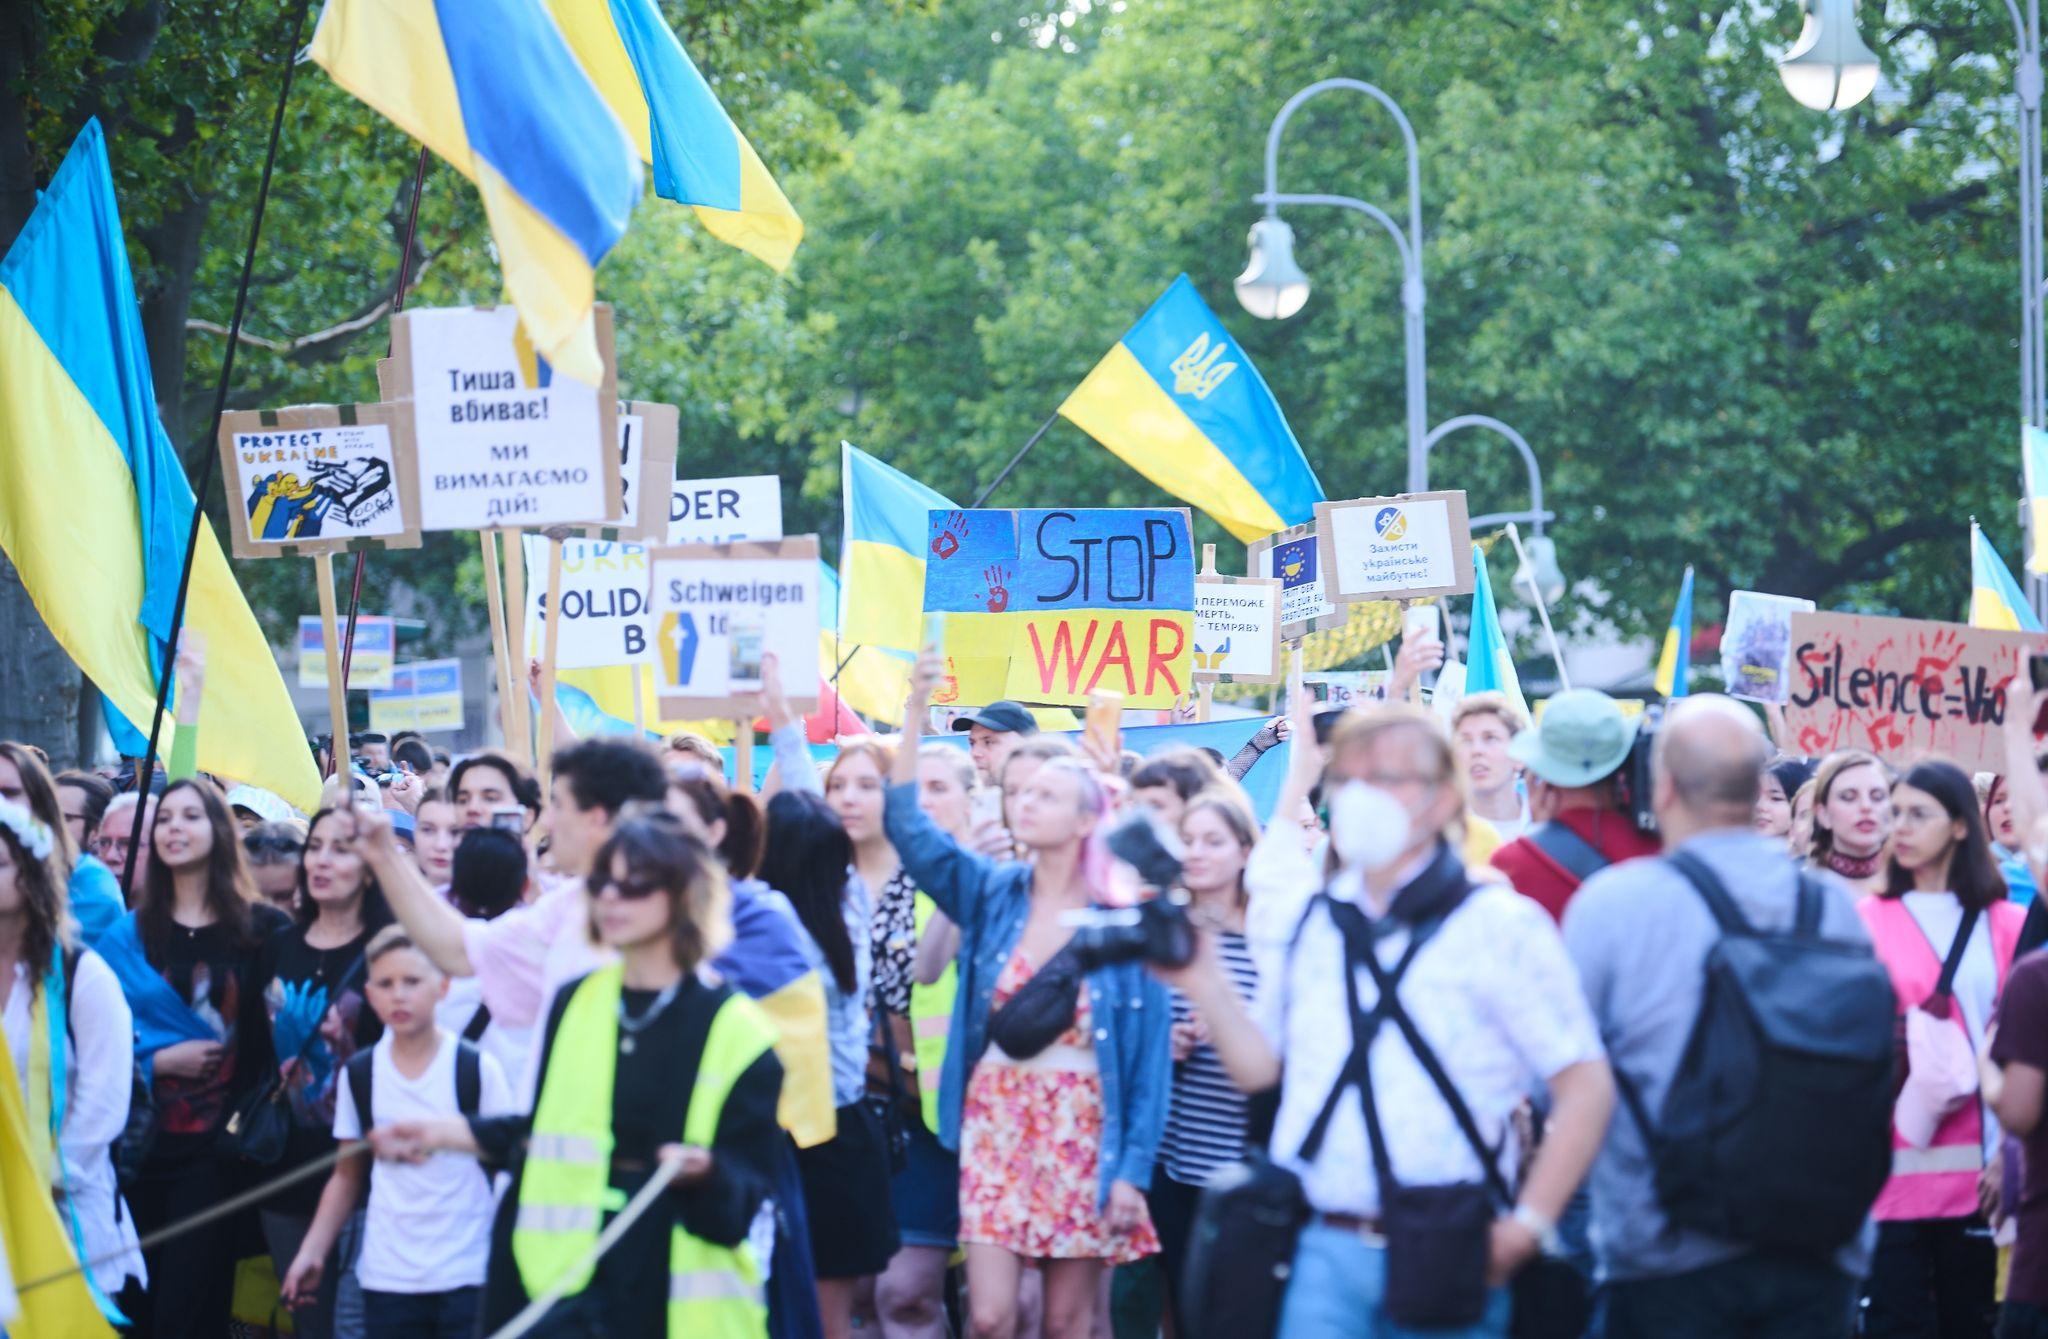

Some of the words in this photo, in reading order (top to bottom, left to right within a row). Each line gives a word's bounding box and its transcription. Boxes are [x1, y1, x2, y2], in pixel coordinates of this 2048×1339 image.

[449, 370, 515, 391] Тиша
[451, 397, 549, 423] вбиває!
[240, 432, 322, 448] PROTECT
[434, 468, 588, 491] ВИМАГАЄМО
[487, 493, 538, 517] ДІЙ!
[1036, 511, 1177, 602] STOP
[1369, 542, 1418, 554] Захисти
[1361, 556, 1429, 571] українське
[1366, 569, 1428, 583] майбутнє!
[670, 580, 803, 606] Schweigen
[1201, 597, 1265, 608] ПЕРЕМОЖЕ
[1195, 609, 1235, 619] МЕРТЬ,
[1208, 622, 1261, 632] ТЕМРЯВУ
[1026, 618, 1185, 697] WAR
